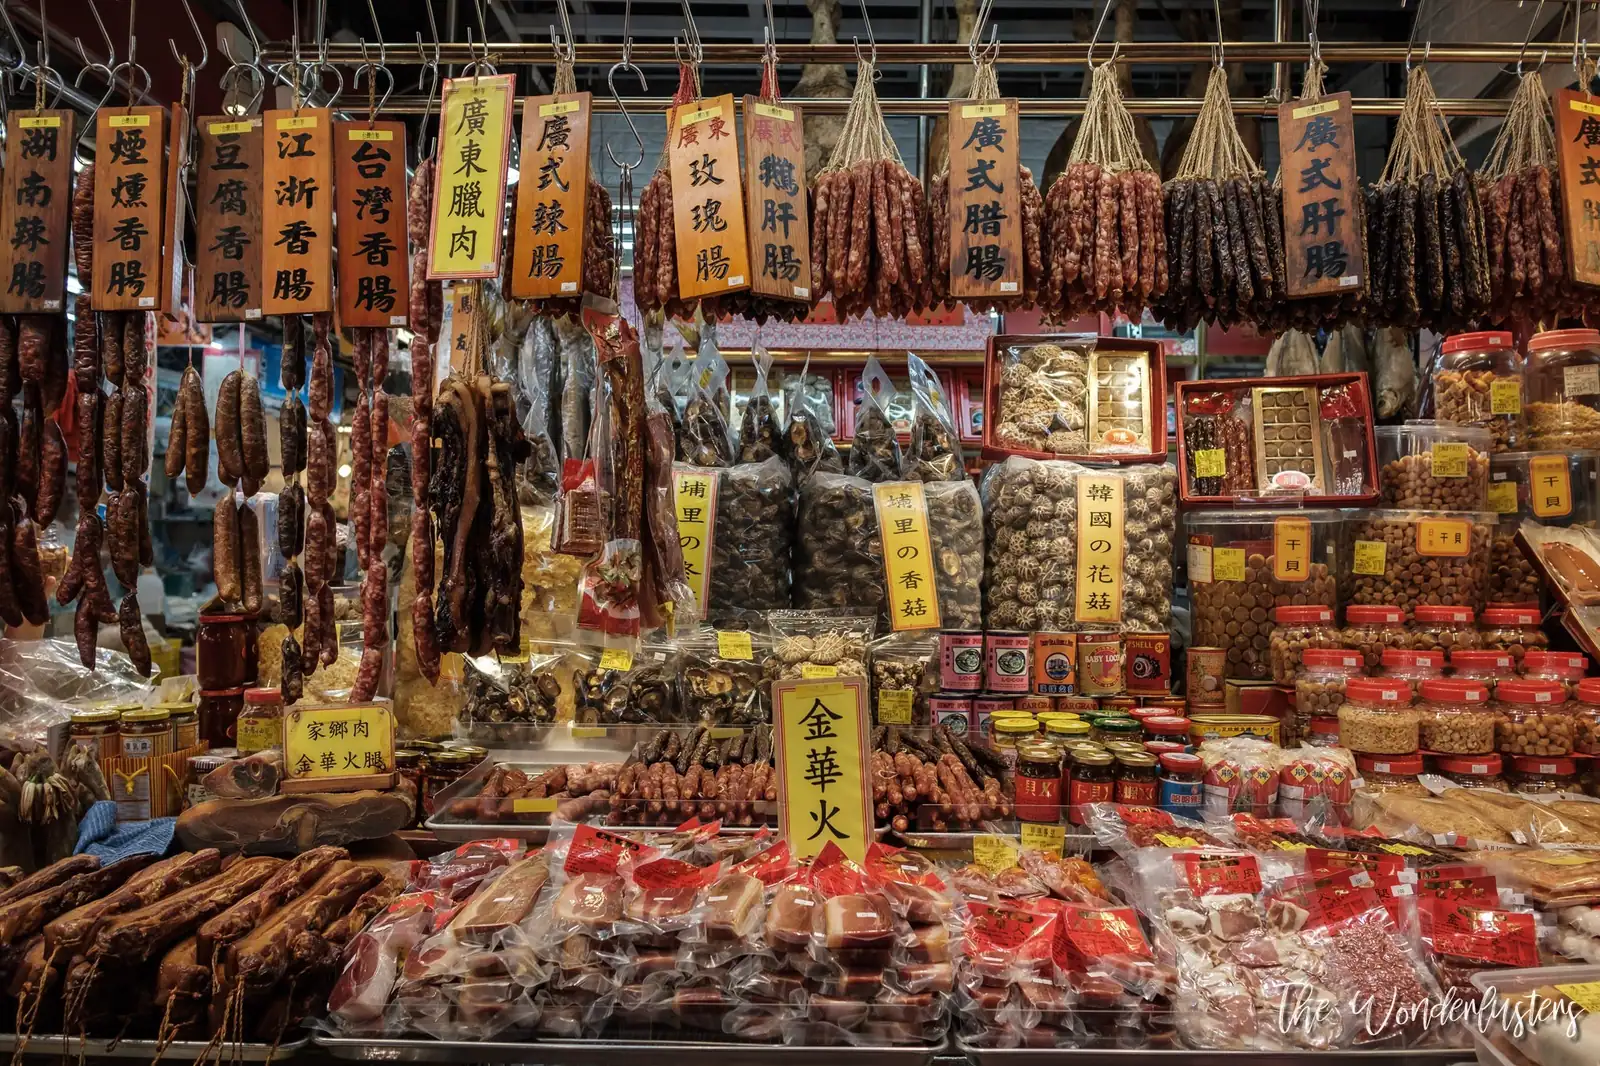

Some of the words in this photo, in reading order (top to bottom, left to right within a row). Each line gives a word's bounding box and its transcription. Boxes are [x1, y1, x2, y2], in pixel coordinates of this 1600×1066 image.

[7, 128, 57, 299] 湖南辣腸
[208, 134, 251, 309] 豆腐香腸
[352, 141, 397, 313] 台灣香腸
[447, 97, 489, 260] 廣東臘肉
[528, 115, 572, 279] 廣式辣腸
[688, 153, 731, 282] 玫瑰腸
[1293, 116, 1348, 279] 廣式肝腸
[887, 494, 927, 617] 埔里の香菇
[1085, 483, 1114, 611] 韓國の花菇
[1285, 539, 1301, 572] 干貝
[1439, 531, 1462, 545] 干貝
[1543, 476, 1561, 508] 干貝
[295, 751, 385, 774] 金華火腿
[306, 719, 370, 741] 家鄉肉
[798, 698, 850, 841] 金華火
